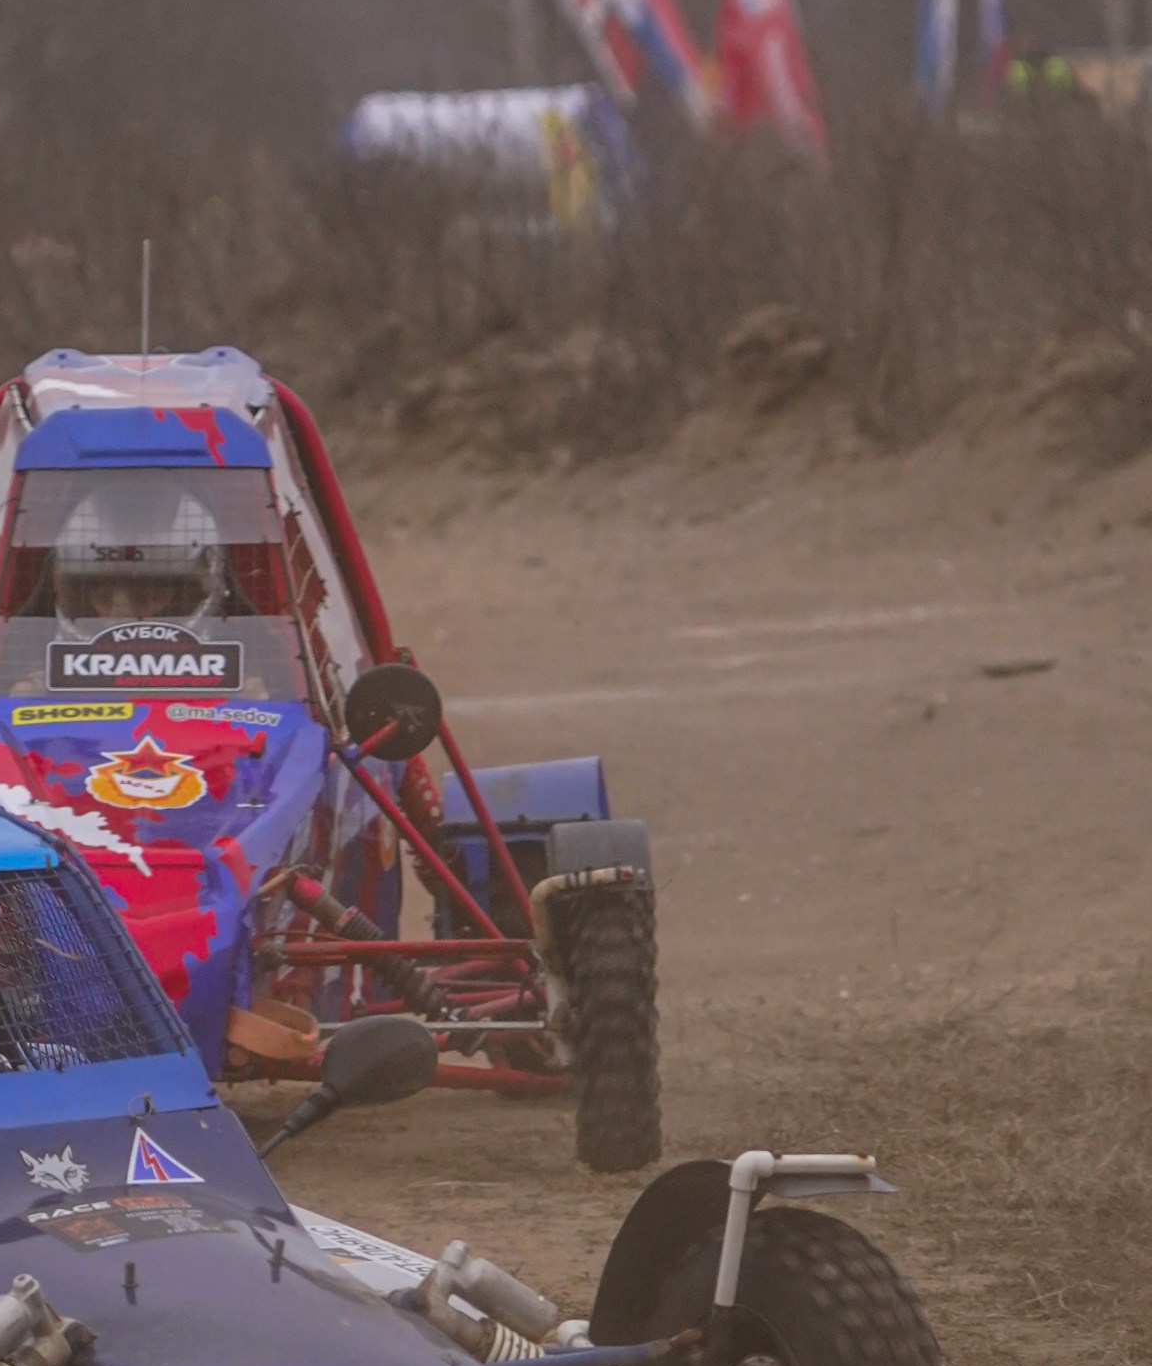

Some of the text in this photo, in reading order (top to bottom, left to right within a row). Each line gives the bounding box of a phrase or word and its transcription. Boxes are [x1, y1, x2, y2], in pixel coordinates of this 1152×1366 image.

[111, 625, 179, 643] КУБОК
[63, 653, 226, 676] KRAMAR
[17, 704, 127, 721] SHONX
[27, 1200, 112, 1224] RACE
